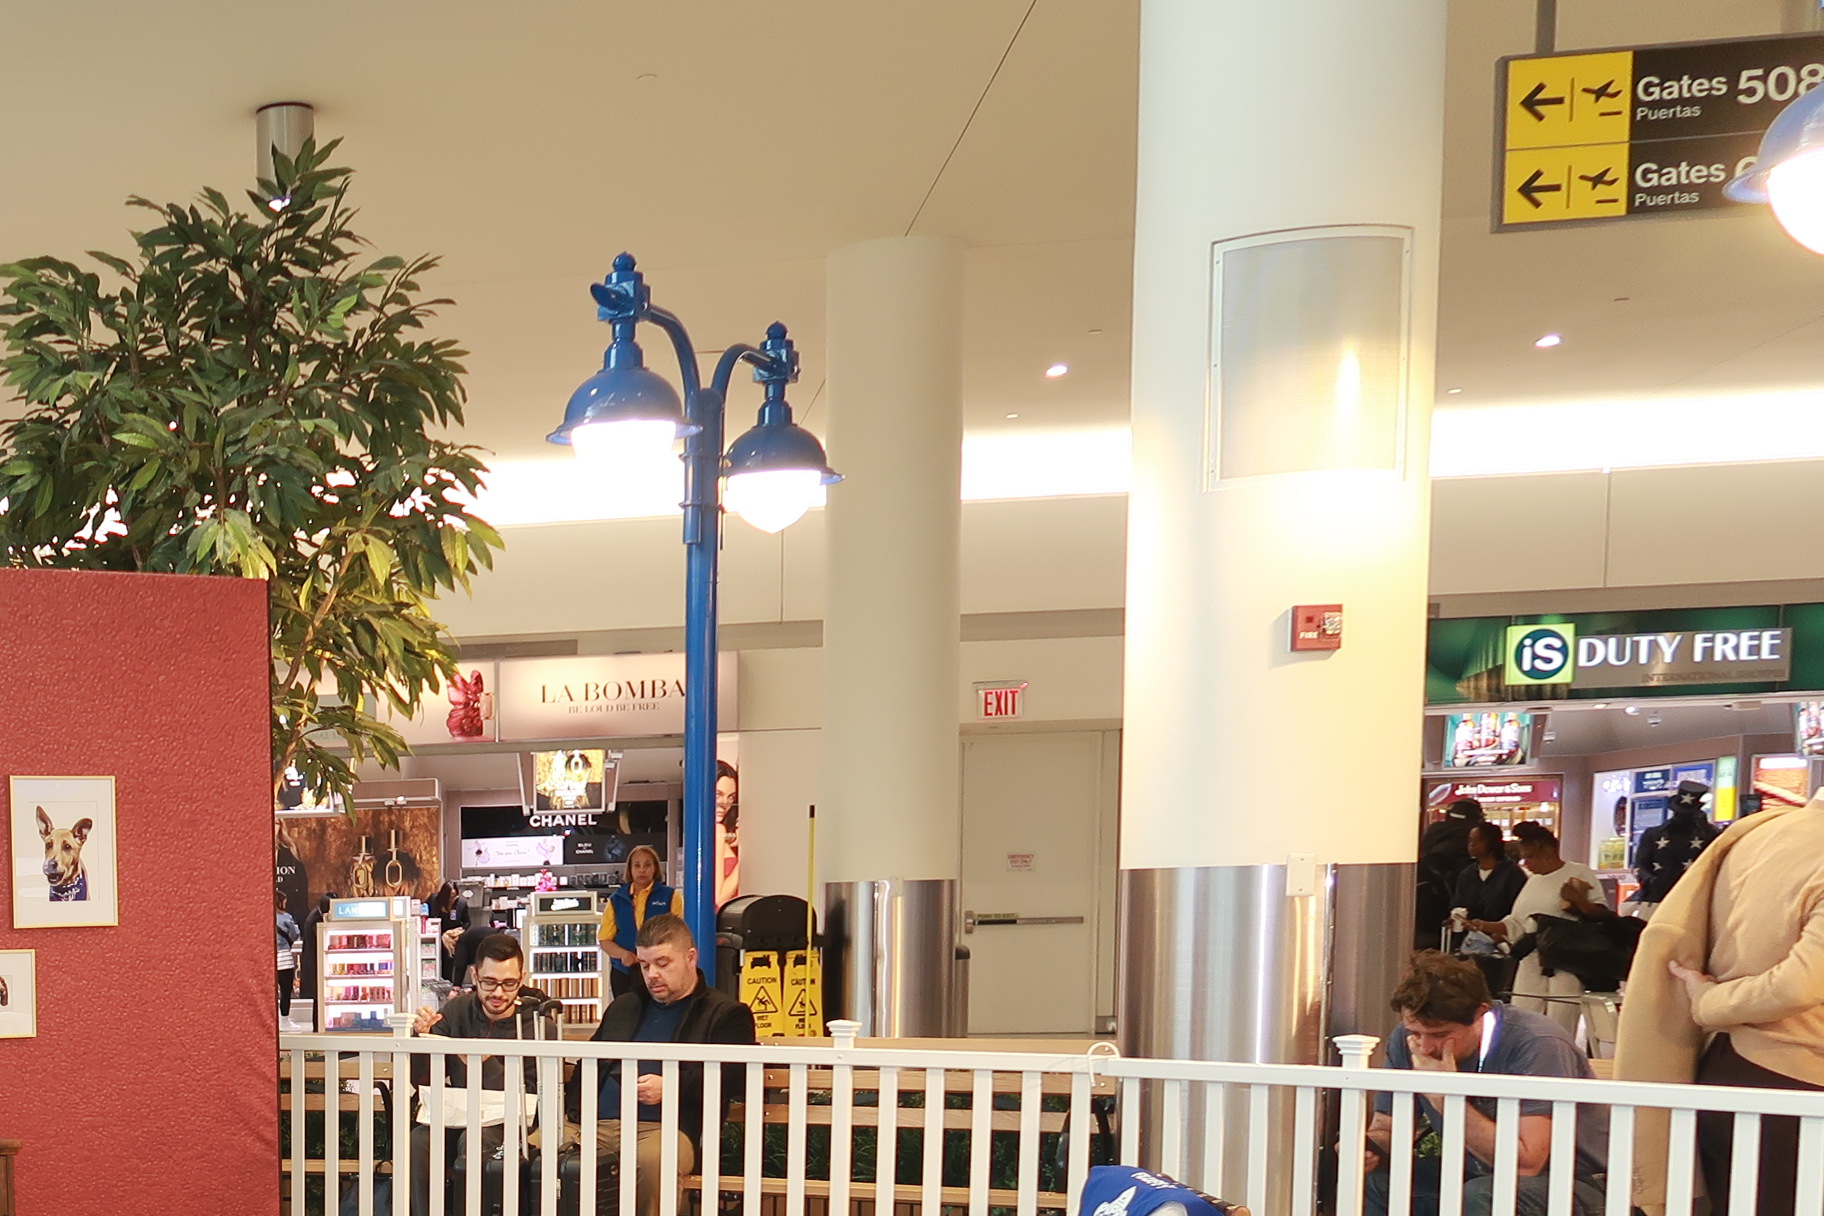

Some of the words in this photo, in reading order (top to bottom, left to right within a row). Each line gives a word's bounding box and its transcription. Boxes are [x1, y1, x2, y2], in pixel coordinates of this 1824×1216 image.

[1636, 74, 1728, 102] Gates
[1635, 105, 1702, 121] Puertas
[1634, 161, 1726, 188] Gates
[1634, 191, 1700, 207] Puertas
[1299, 631, 1319, 639] FIRE
[1521, 637, 1564, 671] iS
[1577, 634, 1683, 668] DUTY
[1693, 630, 1782, 663] FREE
[541, 684, 574, 704] LA
[584, 678, 686, 701] BOMBA
[568, 705, 583, 714] BE
[584, 703, 614, 713] LOUD
[616, 703, 630, 712] BE
[632, 702, 660, 711] FREE
[984, 690, 1019, 716] EXIT
[529, 813, 597, 828] CHANEL
[747, 977, 778, 985] CAUTION
[791, 978, 816, 986] CAUTN
